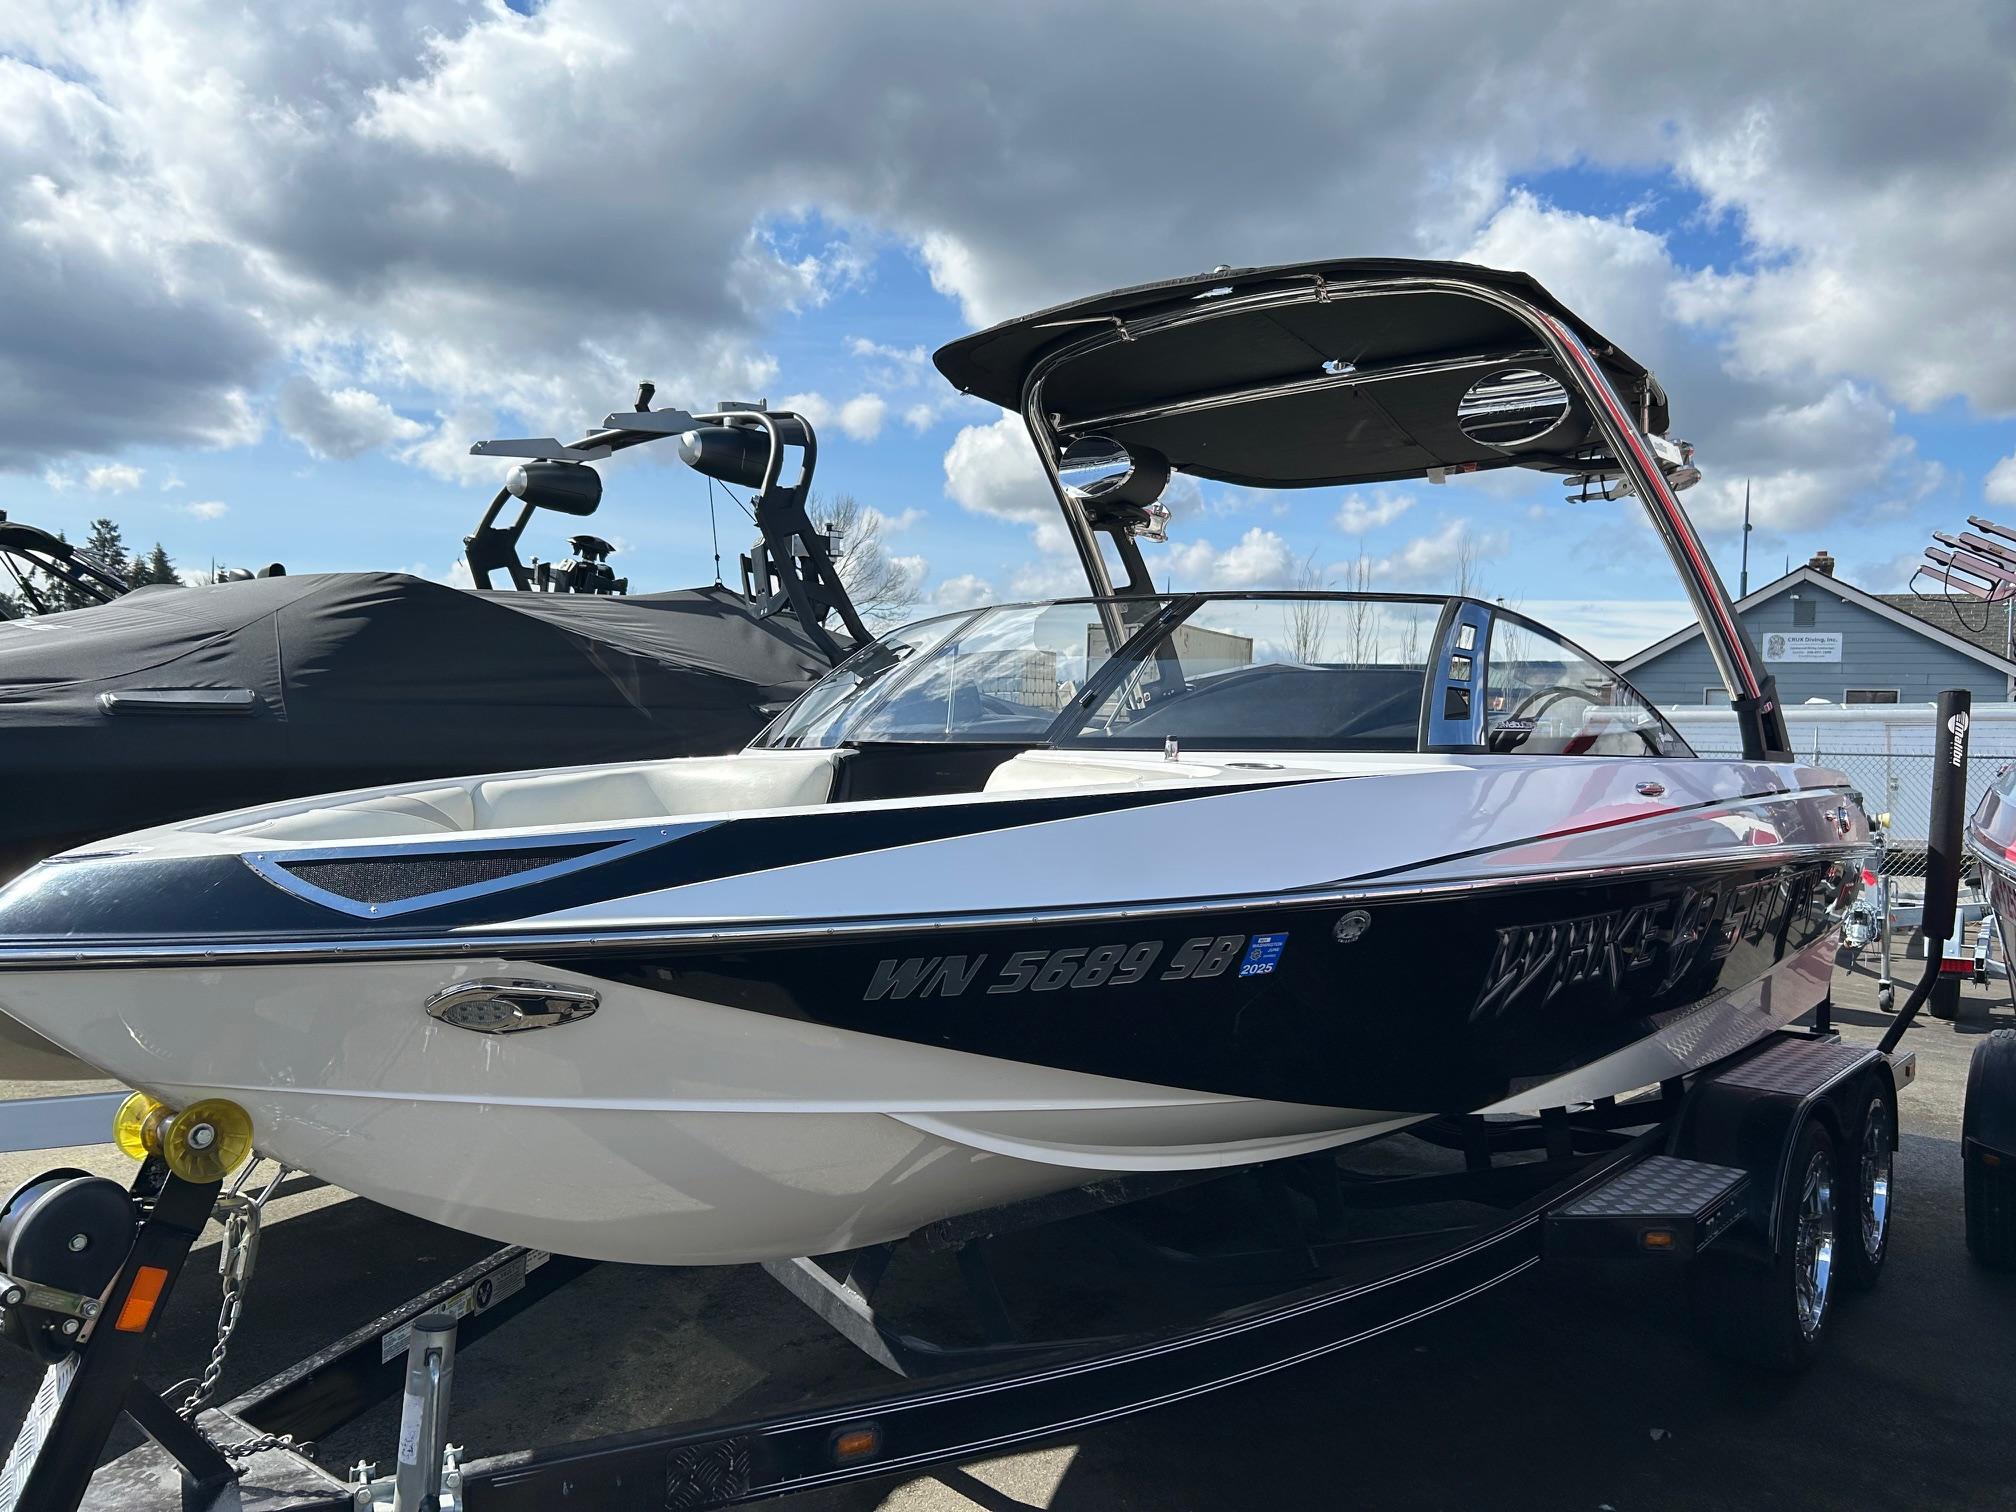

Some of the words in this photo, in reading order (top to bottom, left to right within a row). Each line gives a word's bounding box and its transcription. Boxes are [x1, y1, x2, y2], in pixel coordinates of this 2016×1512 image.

[863, 953, 988, 1000] WN
[986, 940, 1164, 994] 5689
[1160, 934, 1247, 981] SB
[1240, 962, 1274, 975] 2025
